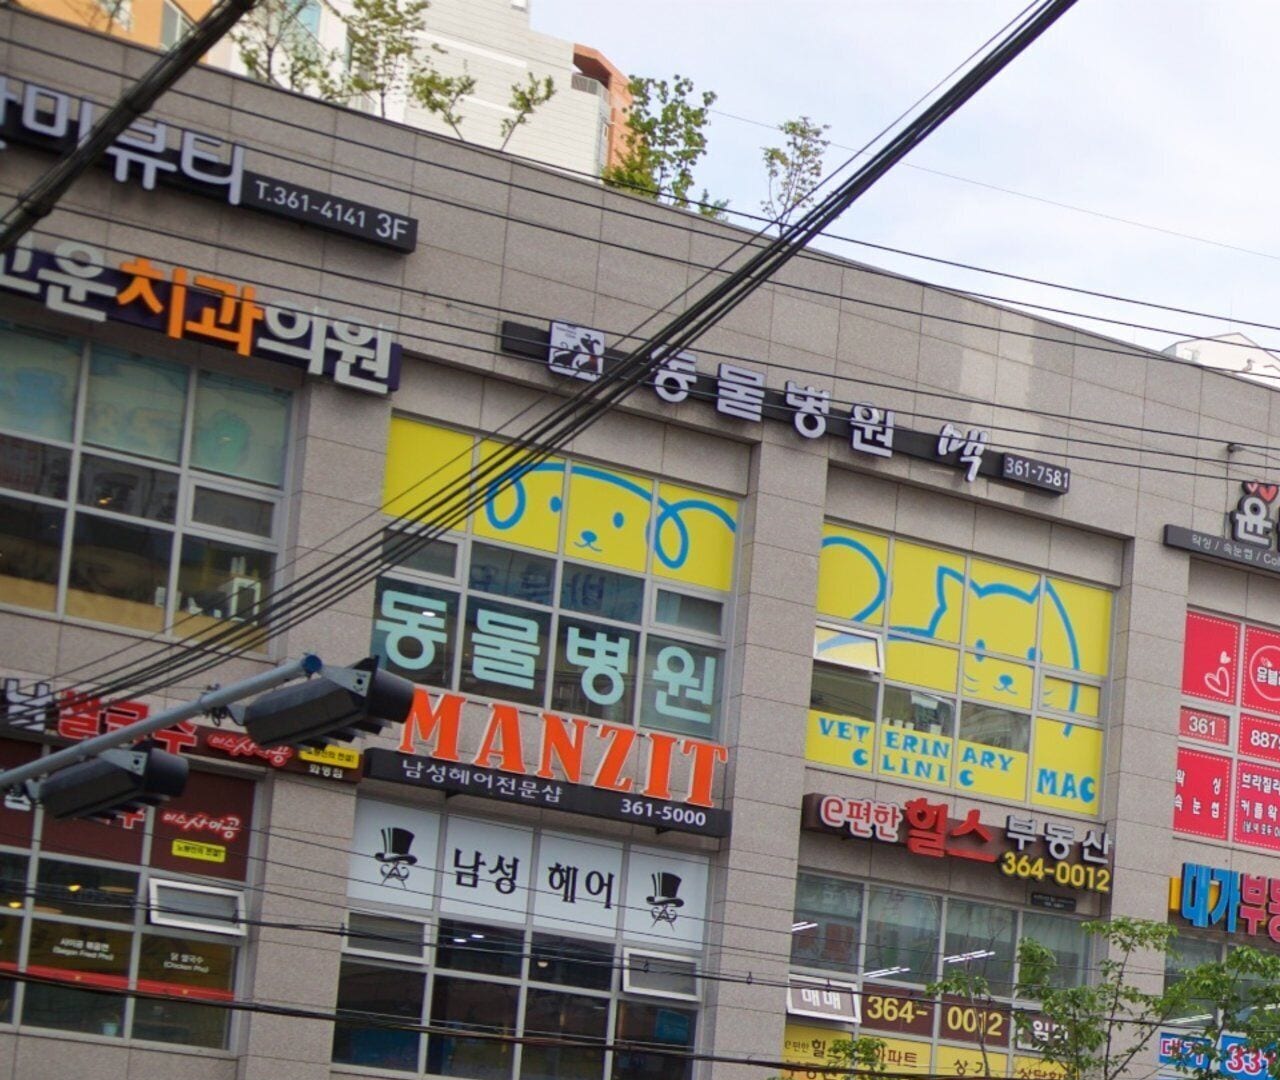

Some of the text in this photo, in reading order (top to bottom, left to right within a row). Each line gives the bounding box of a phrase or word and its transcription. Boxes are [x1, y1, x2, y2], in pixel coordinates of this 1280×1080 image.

[256, 180, 366, 228] T.361-4141
[376, 213, 409, 241] 3F
[650, 346, 896, 458] 동물병원
[1005, 459, 1069, 489] 361-7581
[376, 590, 716, 724] 동물병원
[399, 686, 728, 807] MANZIT
[1188, 715, 1216, 736] 361
[402, 759, 707, 827] 남성헤어전문샵 361-5000
[1035, 767, 1096, 804] MAC
[1006, 814, 1113, 865] 부동산
[453, 848, 615, 909] 남성 헤어
[1001, 850, 1112, 892] 364-0012
[1182, 862, 1240, 933] 대가
[802, 988, 841, 1011] 매매
[866, 996, 929, 1023] 364-
[946, 1006, 1003, 1037] 0012
